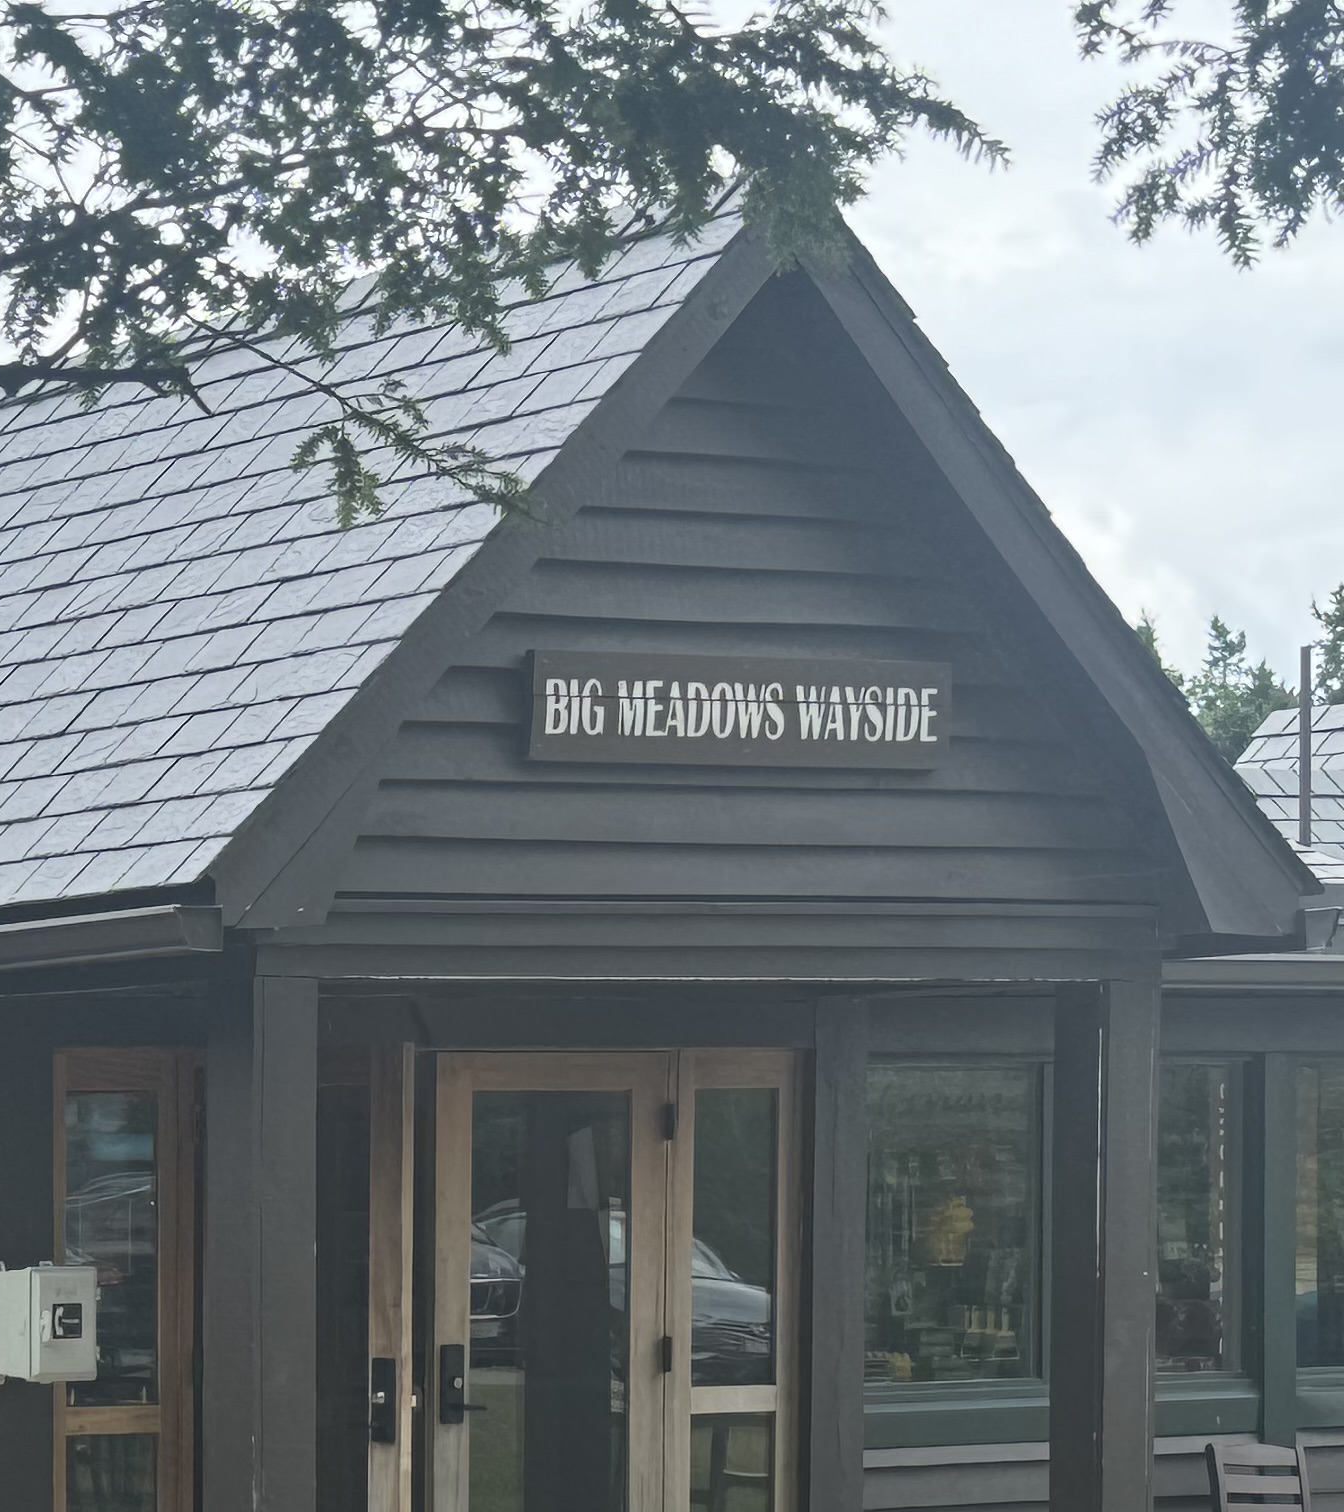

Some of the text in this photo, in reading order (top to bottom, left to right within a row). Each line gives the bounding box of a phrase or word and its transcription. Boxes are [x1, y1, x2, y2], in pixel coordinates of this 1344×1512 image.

[544, 678, 938, 742] BIG MEADOWS WAYSIDE
